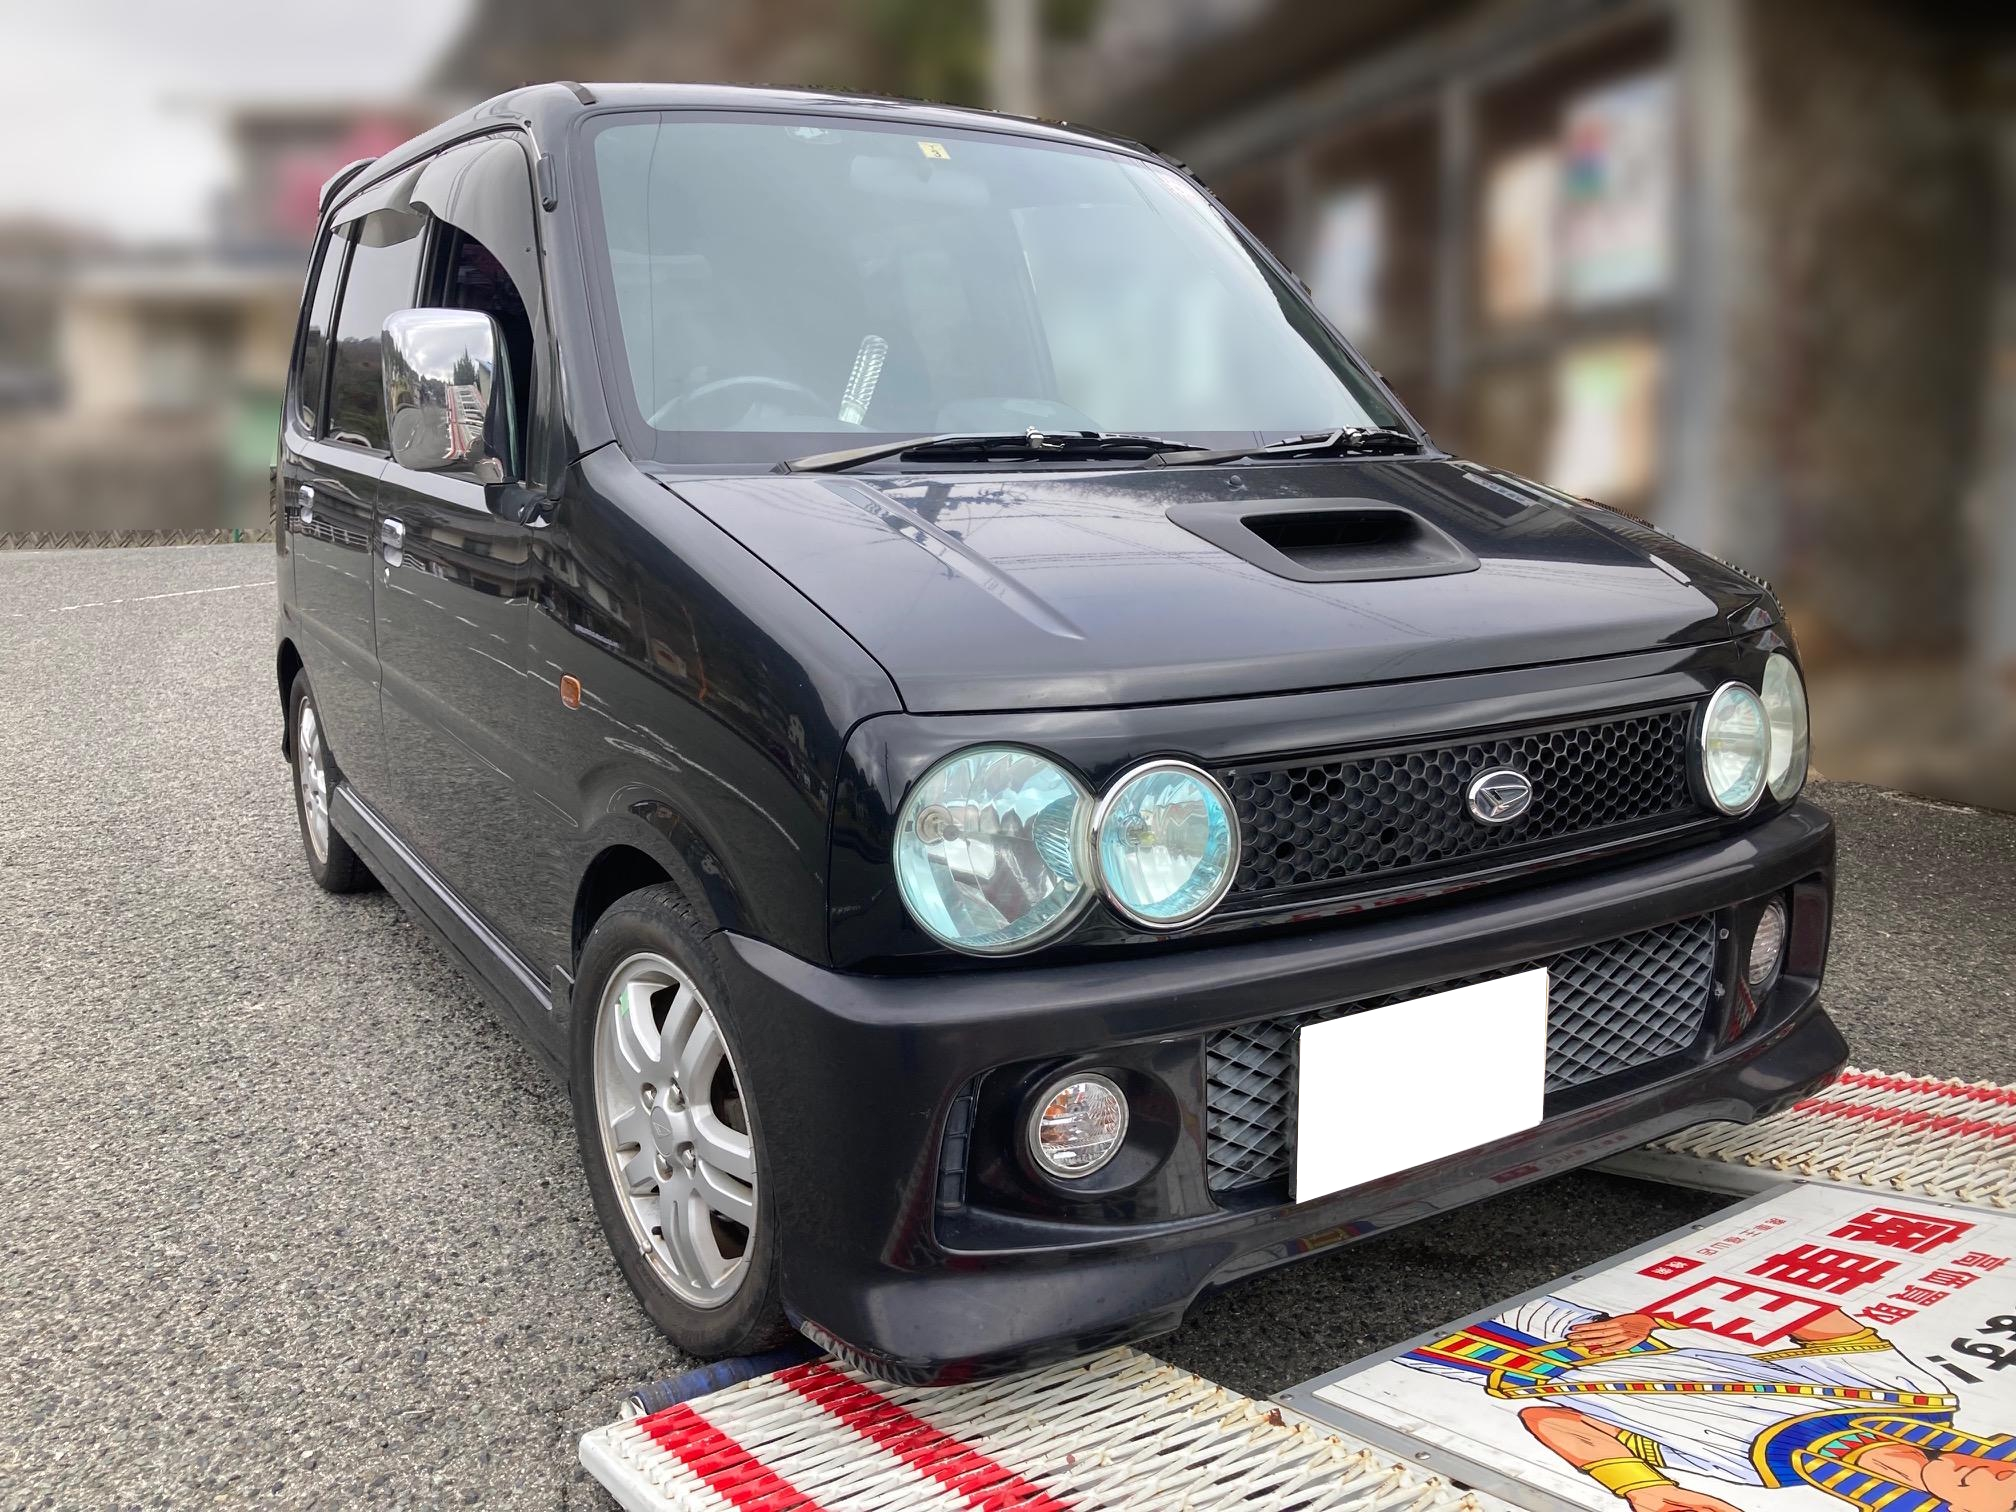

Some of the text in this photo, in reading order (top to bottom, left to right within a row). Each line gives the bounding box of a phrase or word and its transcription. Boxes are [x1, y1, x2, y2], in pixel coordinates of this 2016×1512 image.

[1637, 1207, 1976, 1346] 廃車王
[1854, 1251, 2011, 1325] 高価買取
